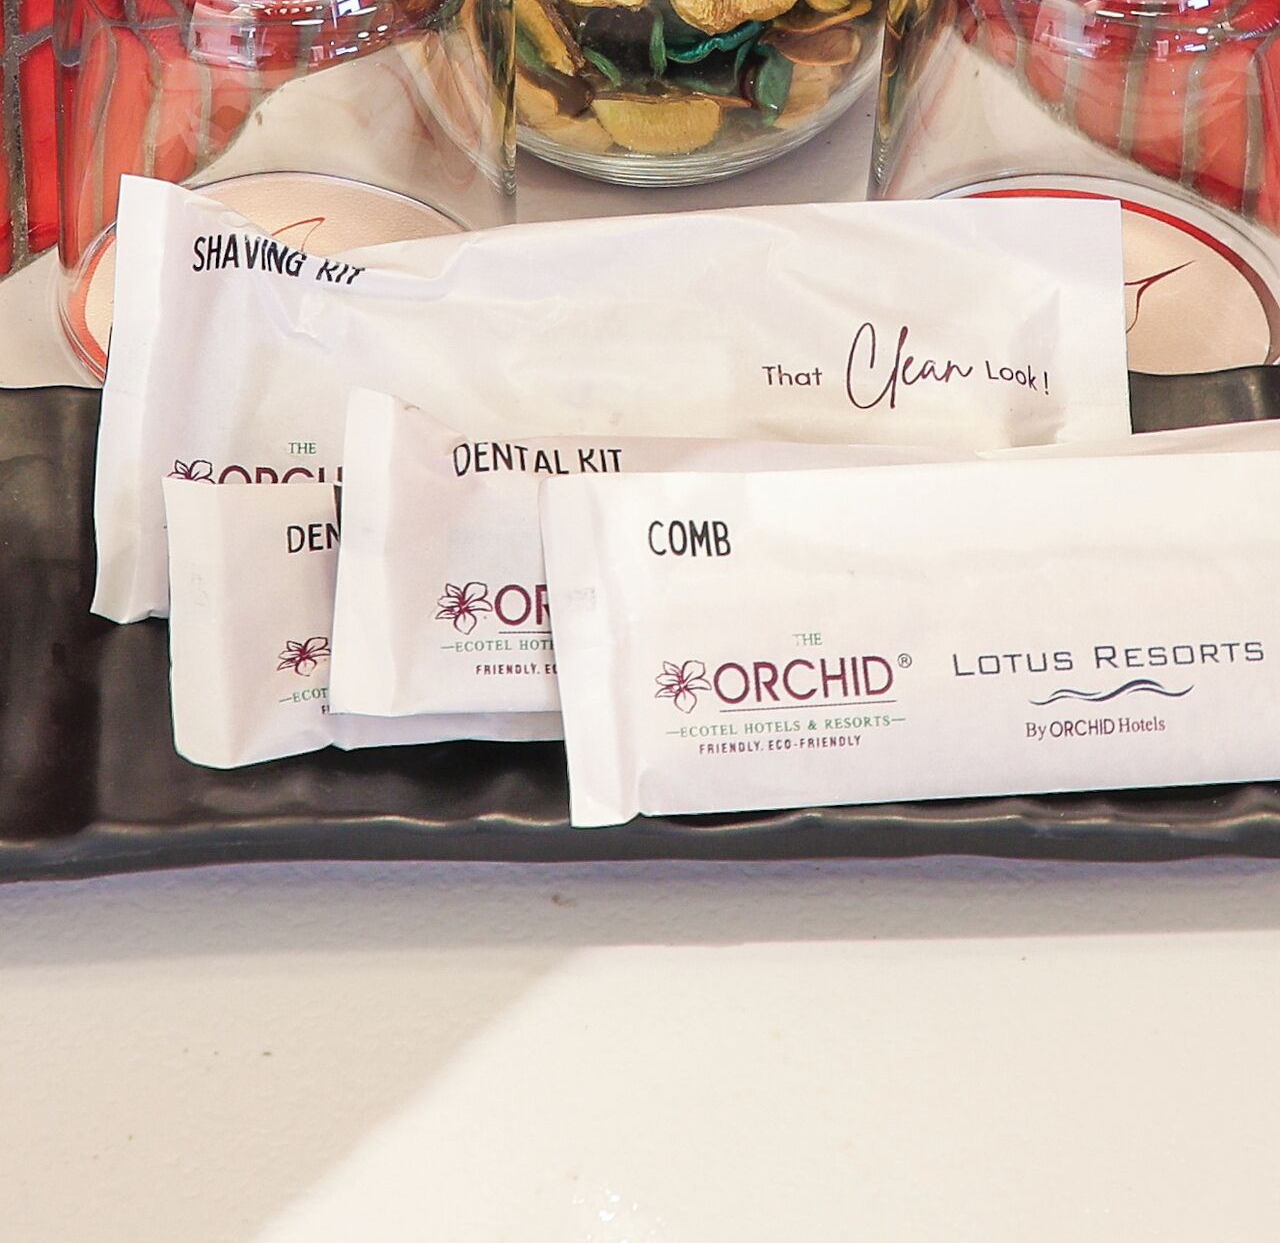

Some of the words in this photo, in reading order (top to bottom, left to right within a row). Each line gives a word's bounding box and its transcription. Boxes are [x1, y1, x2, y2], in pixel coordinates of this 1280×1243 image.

[192, 234, 307, 277] SHAVING
[315, 258, 366, 285] KIT
[762, 365, 822, 387] That
[846, 322, 973, 409] Clean
[288, 442, 316, 454] THE
[453, 442, 569, 477] DENTAL
[578, 448, 622, 473] KIT
[648, 520, 732, 557] COMB
[455, 639, 513, 652] ECOTEL
[793, 633, 822, 646] THE
[680, 724, 737, 738] ECOTEL
[744, 720, 801, 734] HOTELS
[808, 719, 818, 731] &
[825, 715, 891, 730] RESORTS
[1025, 721, 1047, 741] By
[1049, 717, 1116, 738] ORCHID
[1118, 716, 1166, 734] Hotels
[768, 735, 862, 751] ECO-FRIENDLY
